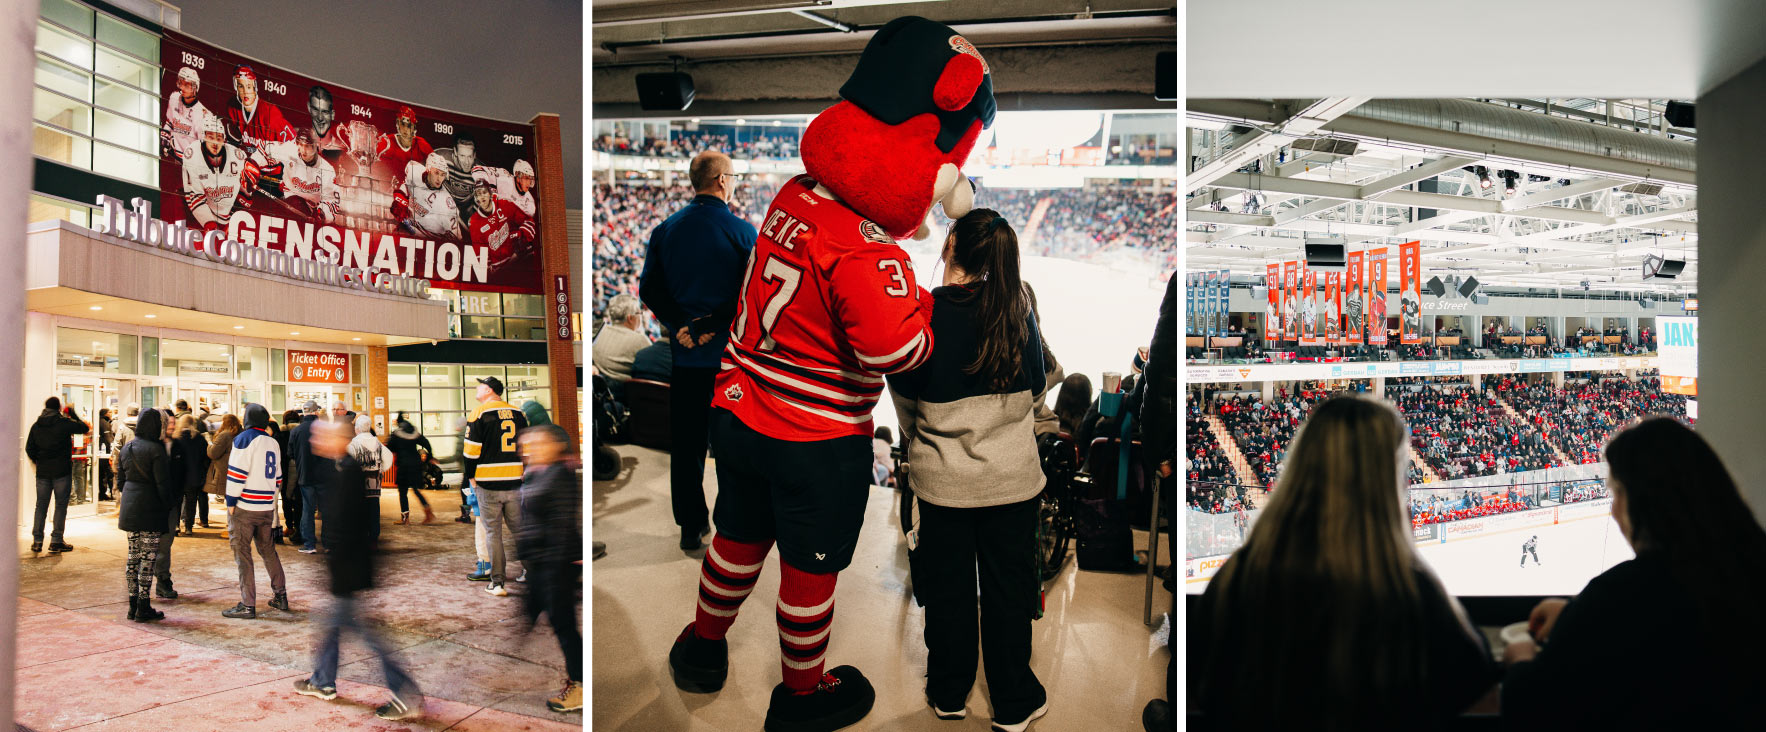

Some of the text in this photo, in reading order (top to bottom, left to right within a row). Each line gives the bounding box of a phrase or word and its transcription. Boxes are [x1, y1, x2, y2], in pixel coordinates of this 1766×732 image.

[181, 51, 205, 70] 1939
[263, 79, 287, 96] 1940
[350, 104, 372, 118] 1944
[433, 122, 454, 135] 1990
[503, 134, 523, 146] 2015
[230, 161, 238, 175] C
[496, 208, 504, 219] C
[762, 208, 810, 251] DEKE
[94, 193, 432, 299] Tribute Communities Centre
[228, 210, 489, 283] GENSNATION
[1352, 264, 1358, 282] 9
[1375, 262, 1381, 281] 9
[1406, 256, 1413, 277] 2
[1269, 275, 1277, 290] 91
[1286, 271, 1295, 288] 88
[557, 277, 569, 337] 1 GATE
[1437, 300, 1468, 311] Street
[1664, 322, 1694, 347] JAN
[291, 352, 346, 366] Ticket Office
[307, 366, 331, 380] Entry
[497, 409, 514, 420] ORR
[501, 420, 516, 452] 2
[265, 451, 276, 479] 8
